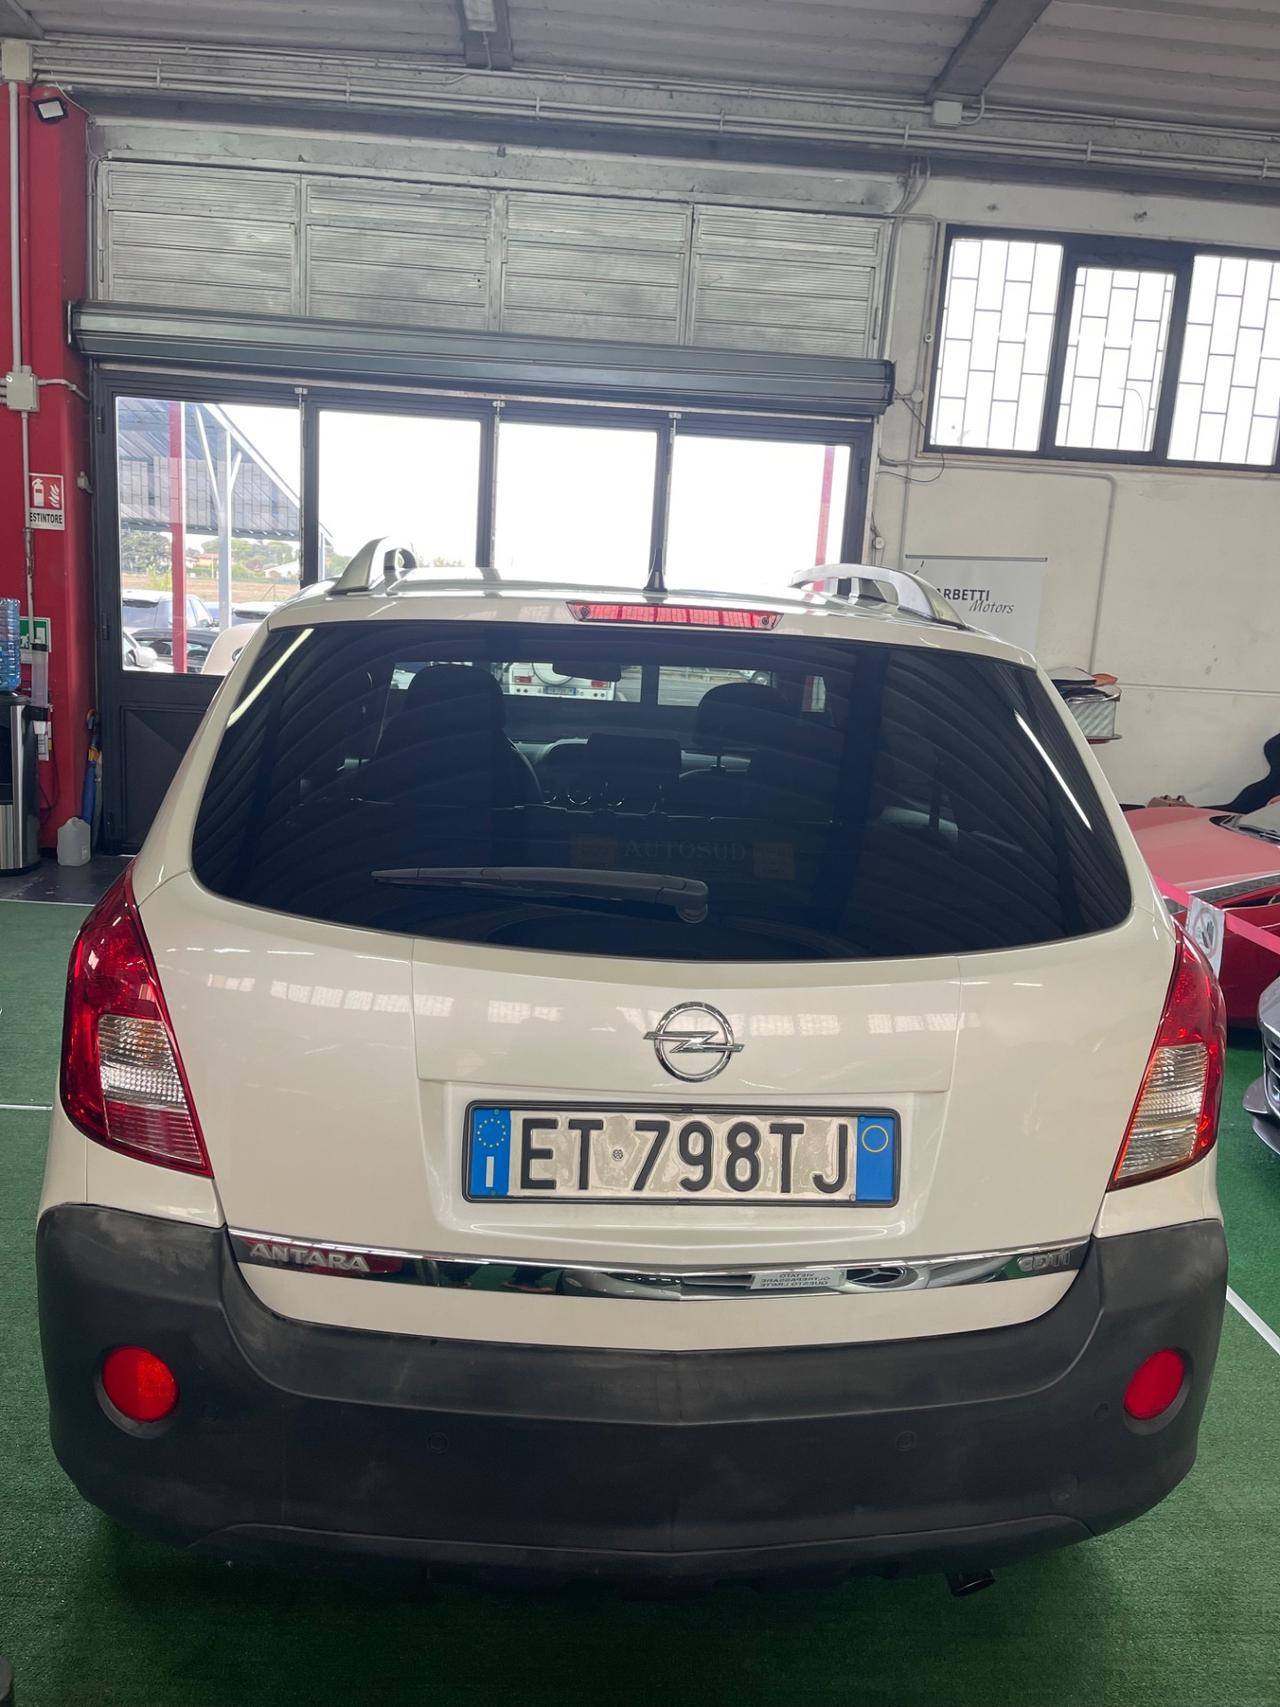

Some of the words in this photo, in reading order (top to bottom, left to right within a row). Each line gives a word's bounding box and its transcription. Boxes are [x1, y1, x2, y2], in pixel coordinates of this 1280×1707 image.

[29, 512, 63, 524] ESTINTORE
[937, 588, 990, 601] RBETTI
[969, 600, 1014, 614] Motors
[623, 839, 747, 861] AUTOSUD
[250, 1242, 370, 1273] ANTARA
